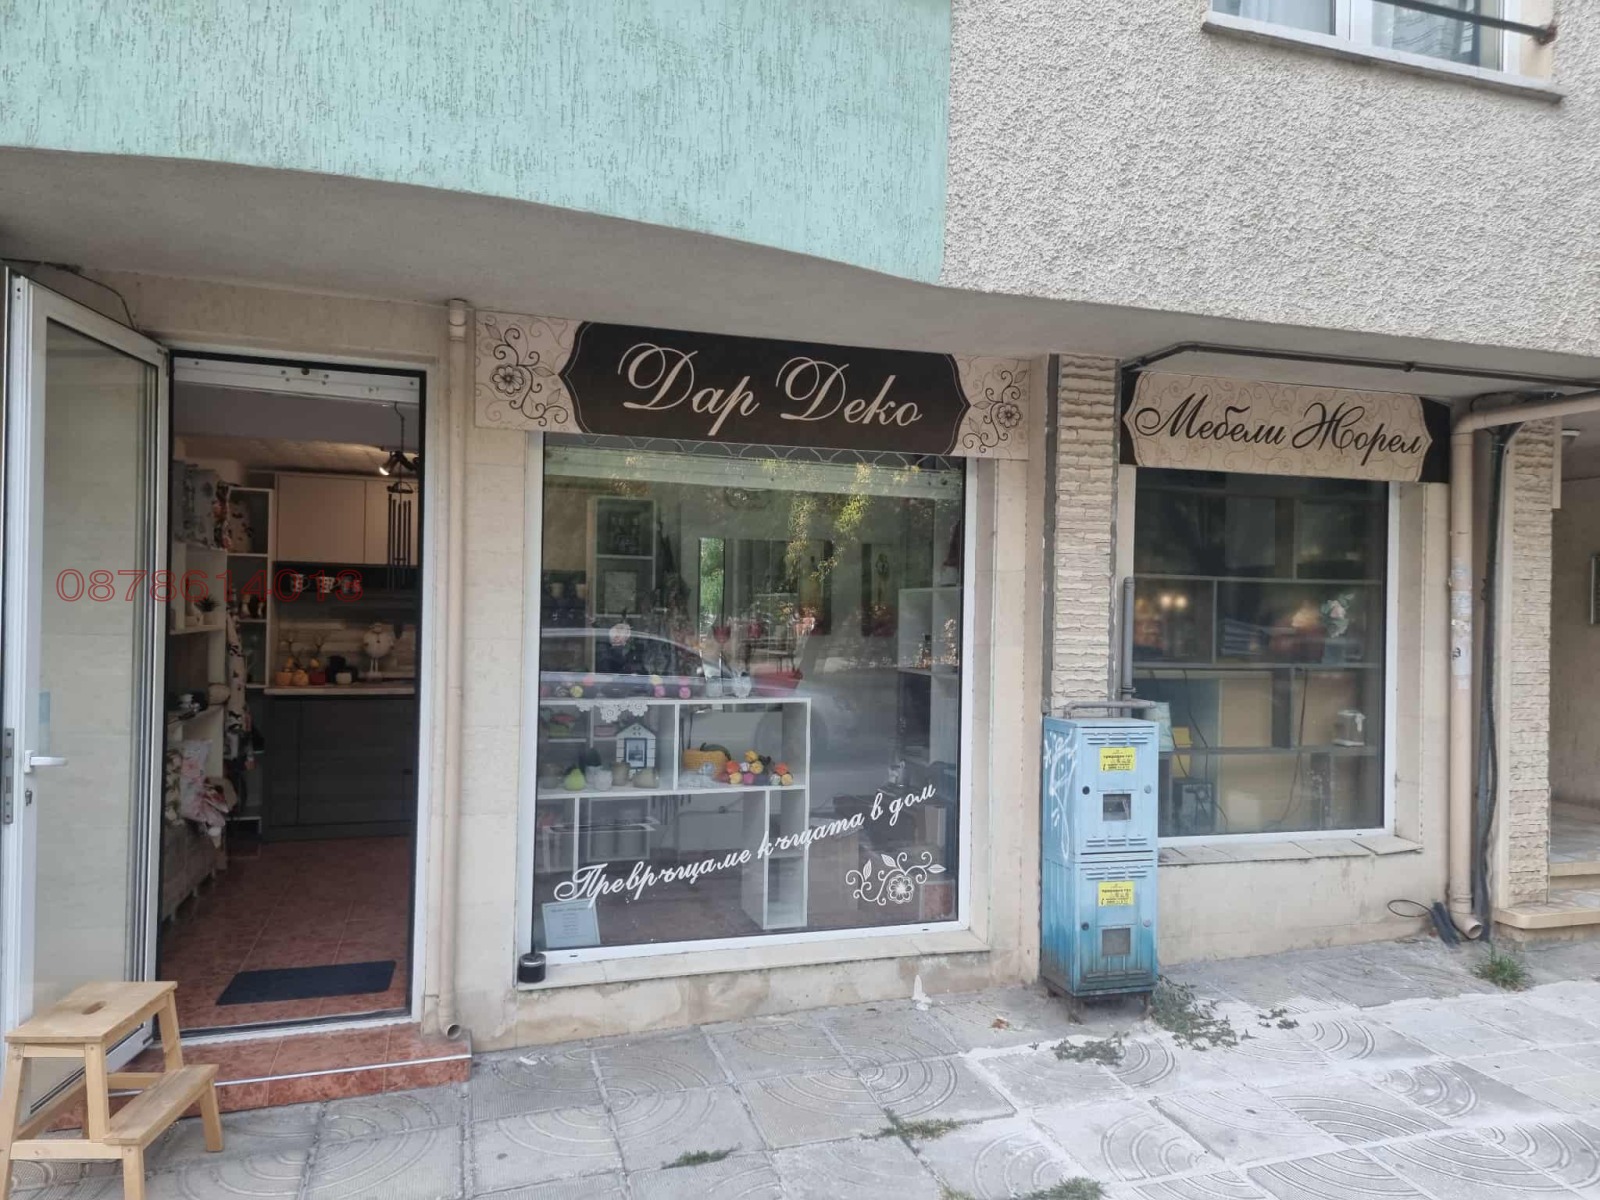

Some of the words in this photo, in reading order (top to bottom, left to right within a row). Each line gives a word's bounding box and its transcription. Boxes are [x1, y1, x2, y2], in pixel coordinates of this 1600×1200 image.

[616, 342, 759, 437] Дар
[1136, 393, 1287, 446] Мебели
[1291, 401, 1422, 466] Жорел
[553, 851, 751, 908] Превръщаме
[757, 811, 865, 860] къщата
[870, 792, 883, 821] в
[889, 782, 937, 827] дом
